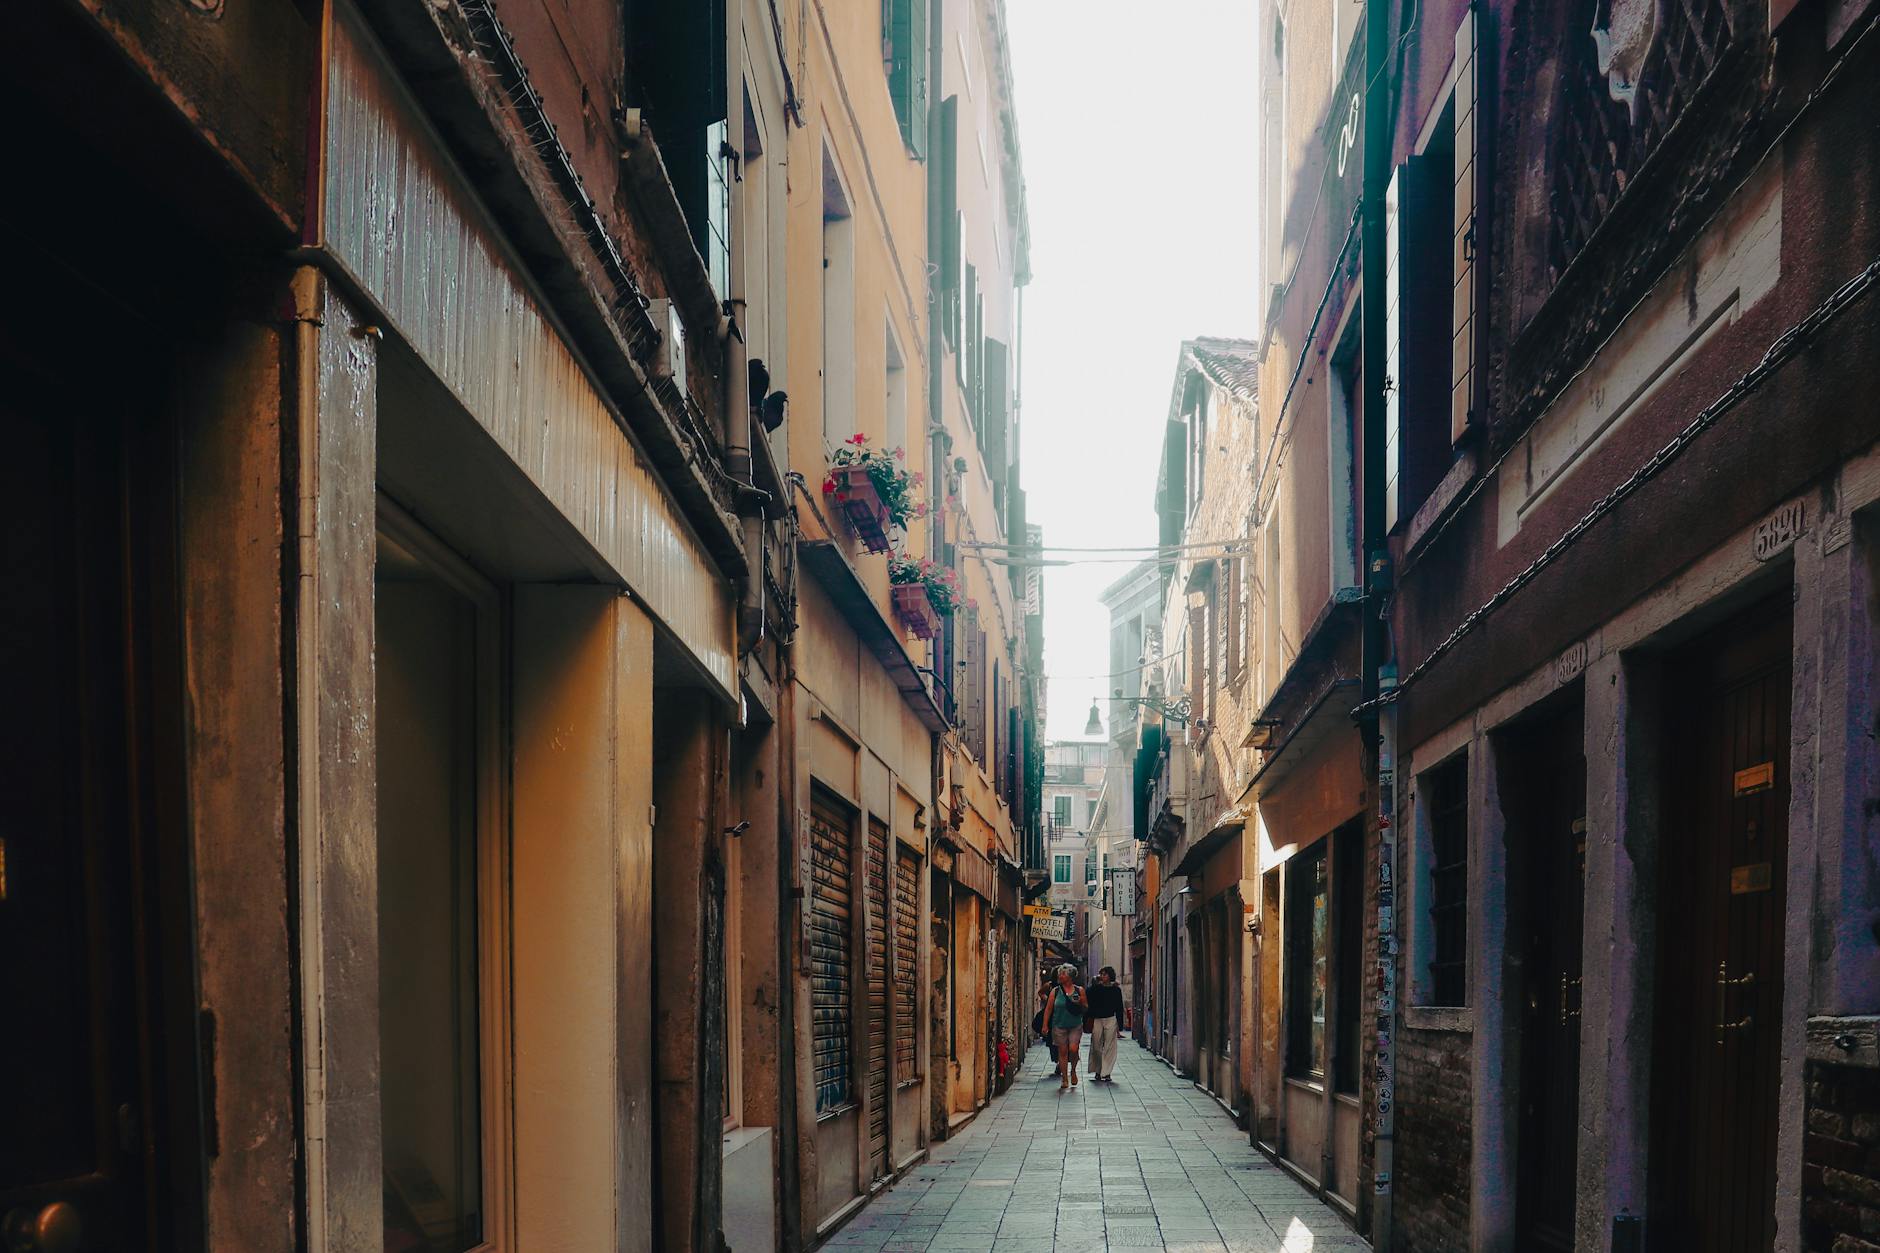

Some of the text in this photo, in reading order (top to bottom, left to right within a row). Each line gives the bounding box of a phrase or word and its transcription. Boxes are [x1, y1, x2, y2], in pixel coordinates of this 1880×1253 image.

[1033, 907, 1049, 915] ATM
[1034, 917, 1063, 927] HOTEL
[1031, 927, 1063, 937] PANTALON
